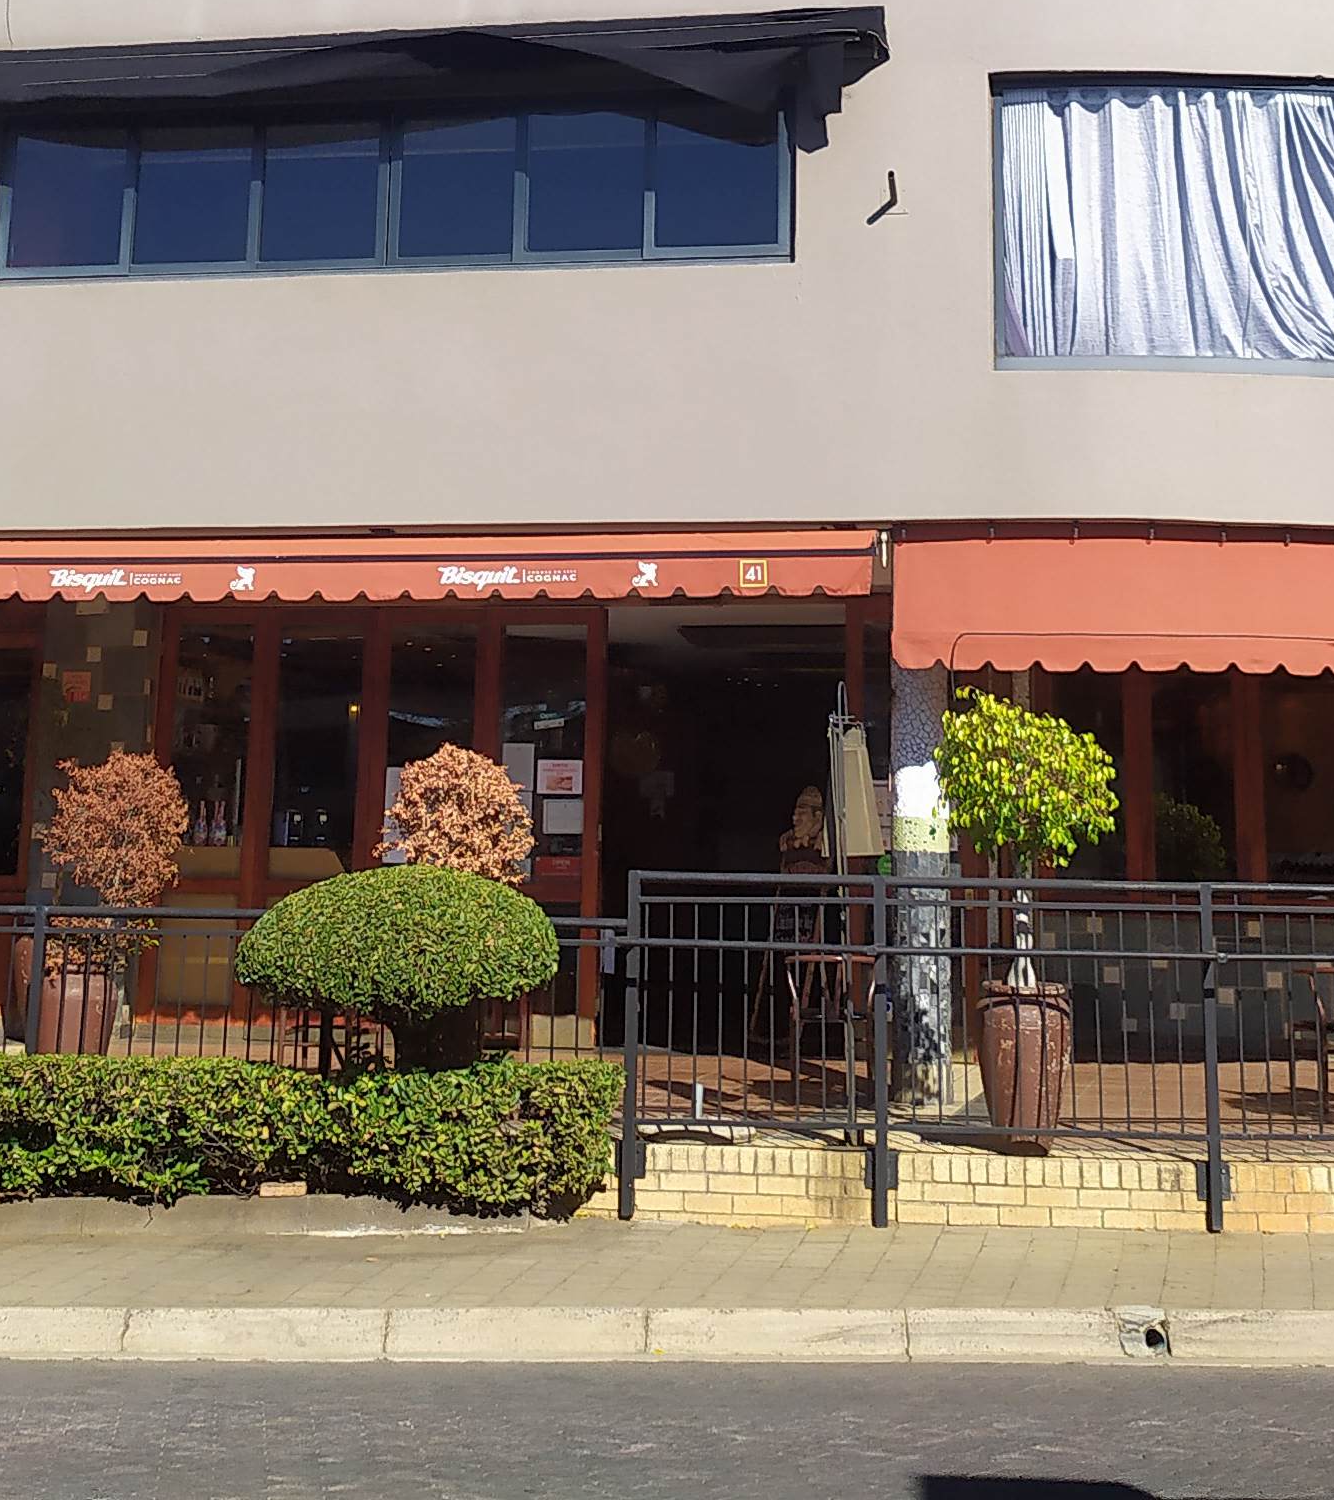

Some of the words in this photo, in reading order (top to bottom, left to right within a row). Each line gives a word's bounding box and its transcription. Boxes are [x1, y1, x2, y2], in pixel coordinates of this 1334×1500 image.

[49, 568, 127, 594] Bisquit
[133, 577, 182, 585] COGNAC
[437, 565, 520, 592] Bisquit
[526, 574, 577, 582] COGNAC
[745, 565, 762, 581] 41
